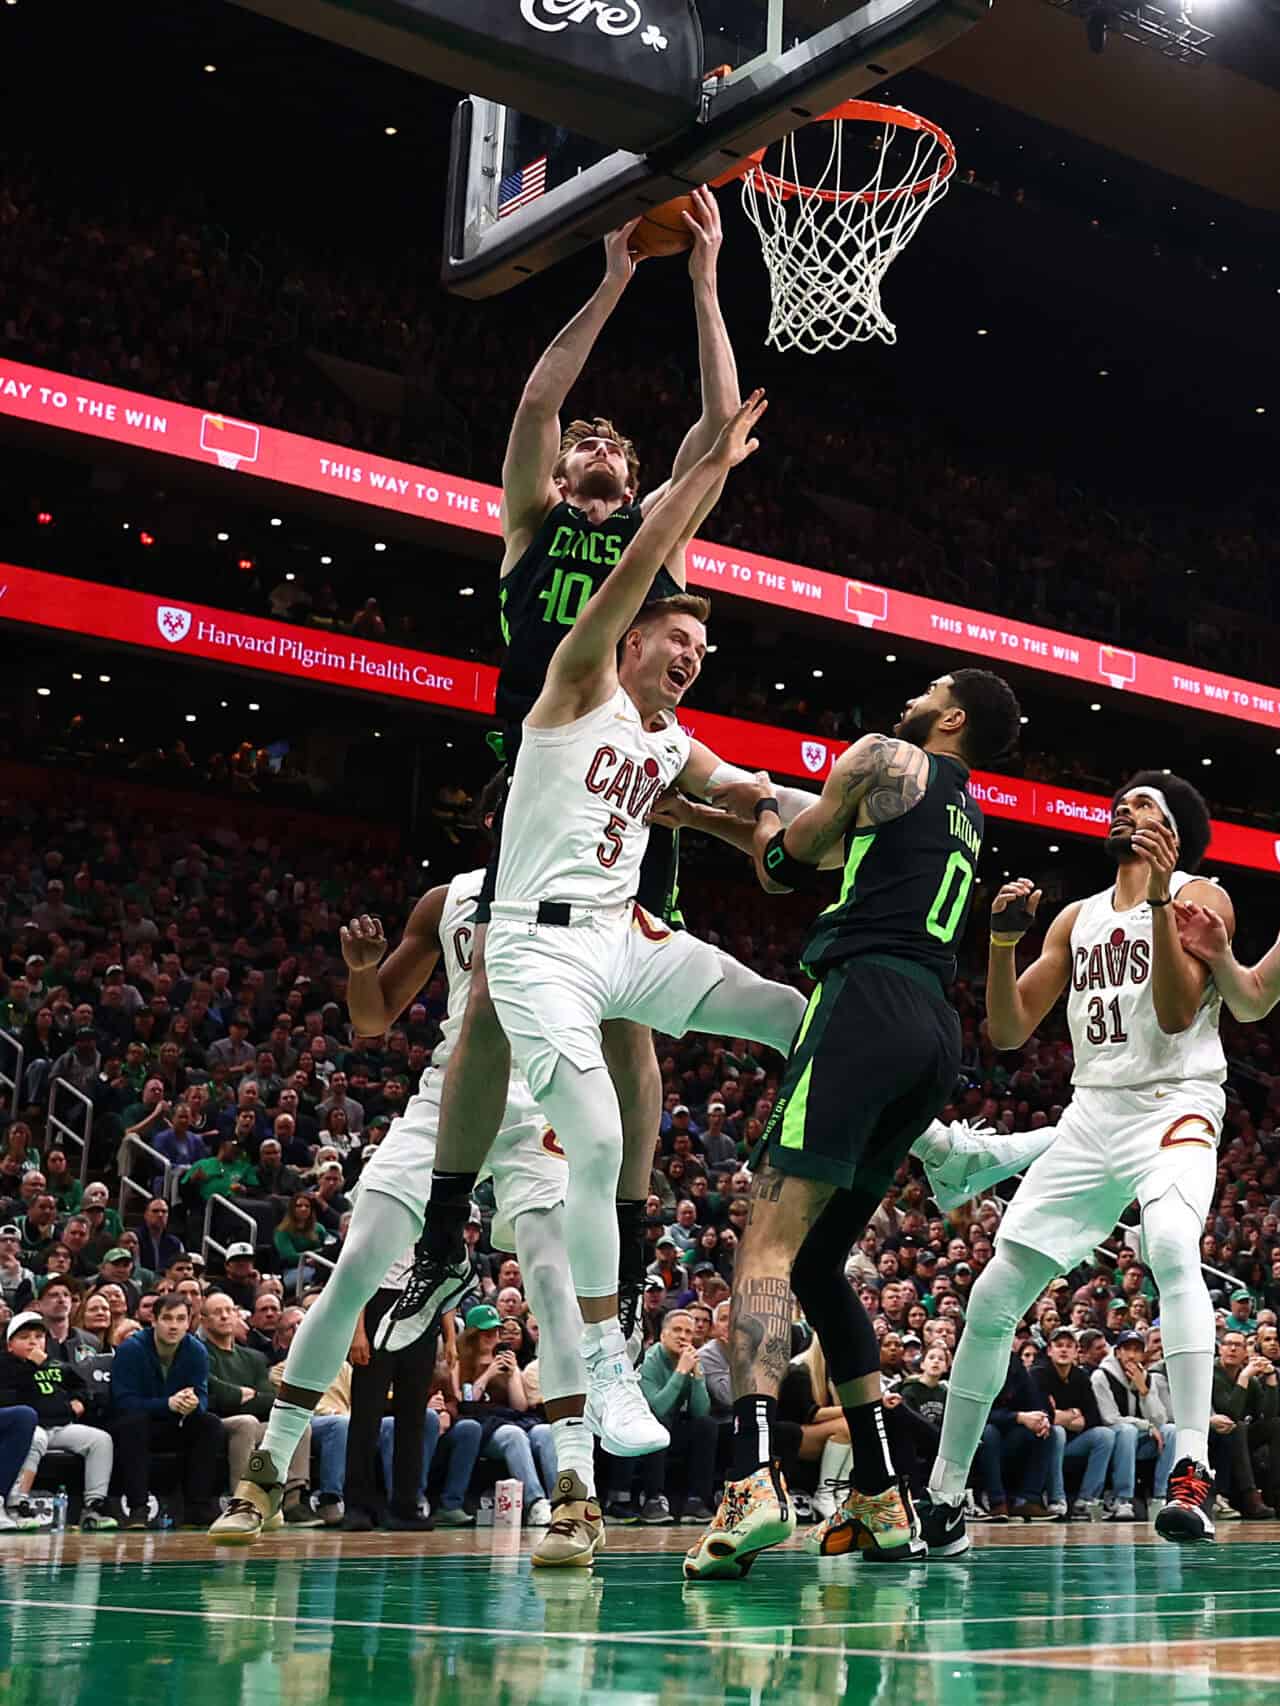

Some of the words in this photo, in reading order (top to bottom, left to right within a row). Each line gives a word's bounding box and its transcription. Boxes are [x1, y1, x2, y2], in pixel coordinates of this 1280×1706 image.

[0, 378, 32, 399] AY
[39, 388, 67, 408] TO
[76, 396, 117, 421] THE
[125, 409, 168, 433] WIN
[320, 459, 362, 483] THIS
[369, 472, 409, 494] WAY
[415, 484, 439, 502] TO
[446, 492, 480, 512] THE
[692, 554, 726, 575] WAY
[731, 564, 752, 581] TO
[756, 570, 785, 590] THE
[791, 579, 822, 599] WIN
[197, 621, 276, 655] Harvard
[279, 638, 345, 670] Pilgrim
[930, 614, 962, 634] THIS
[966, 623, 997, 642] WAY
[1001, 632, 1018, 647] TO
[1023, 638, 1048, 655] THE
[1053, 645, 1080, 663] WIN
[1172, 676, 1201, 694] THIS
[1204, 684, 1230, 701] WAY
[1232, 691, 1249, 706] TO
[1252, 696, 1274, 713] THE
[584, 745, 665, 828] CAV
[1046, 801, 1054, 813] a
[596, 814, 628, 868] 5
[946, 804, 981, 862] TATUM
[926, 851, 973, 943] 0
[1073, 938, 1150, 992] CAVS
[1087, 993, 1128, 1045] 31
